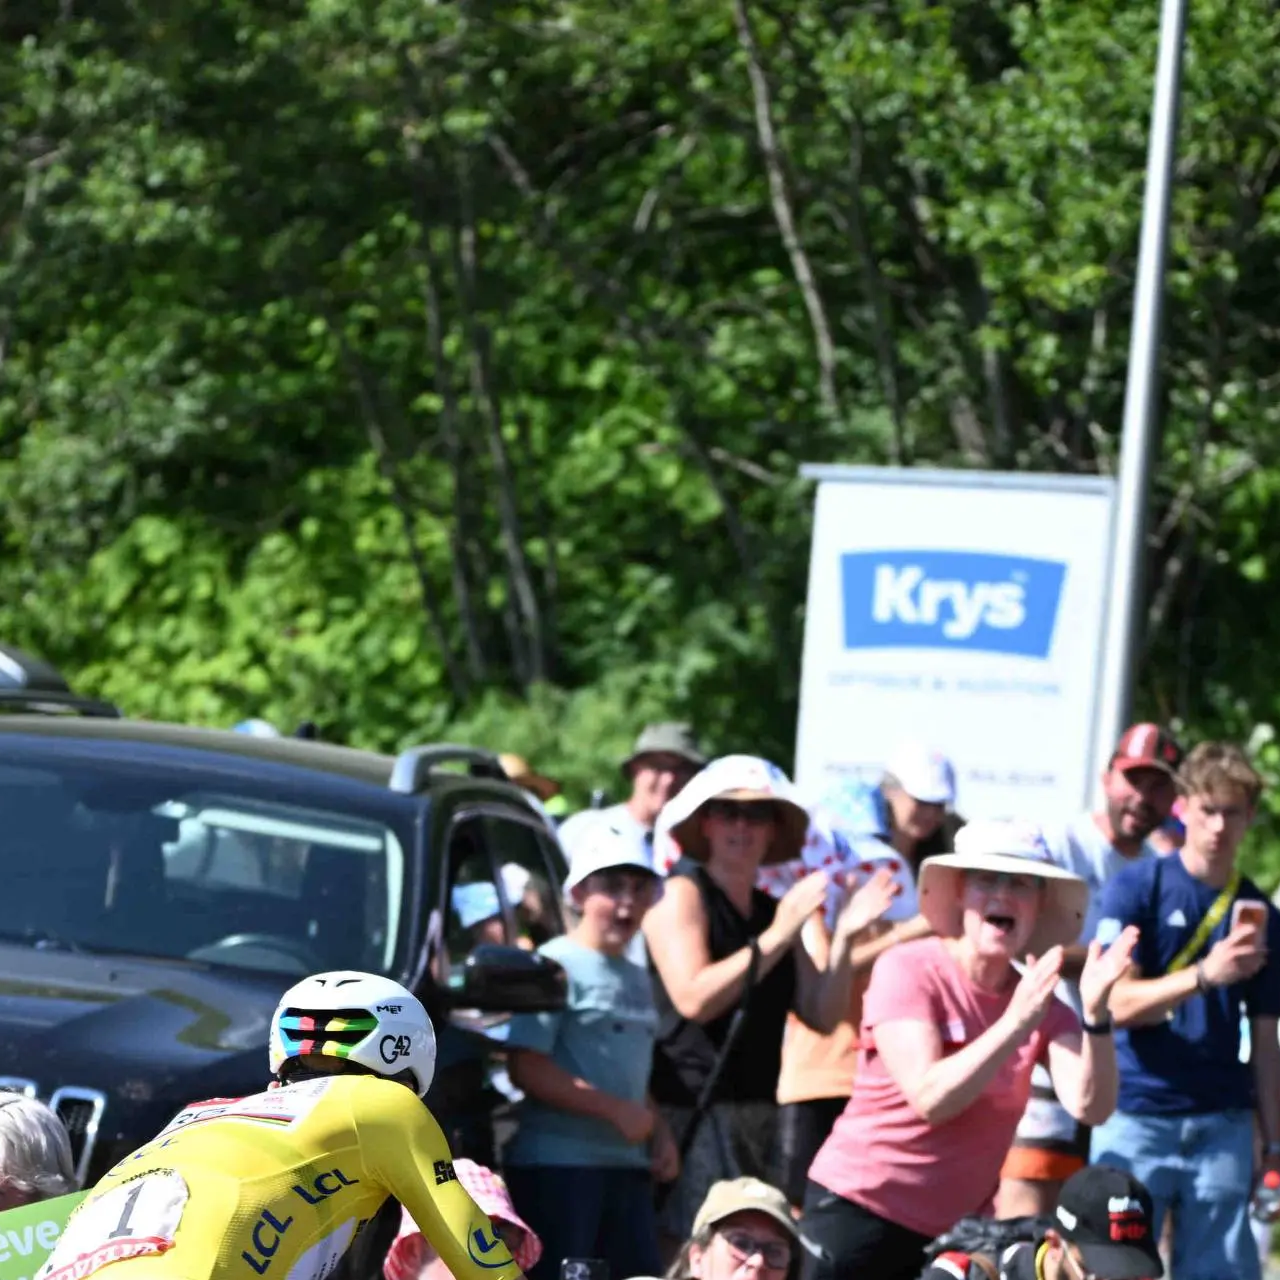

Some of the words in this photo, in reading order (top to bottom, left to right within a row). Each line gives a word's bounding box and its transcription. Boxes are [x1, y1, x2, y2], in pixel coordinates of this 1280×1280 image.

[872, 563, 1026, 640] Krys
[376, 1004, 403, 1014] MET
[108, 1181, 145, 1240] 1
[292, 1168, 360, 1205] LCL
[241, 1208, 294, 1275] LCL
